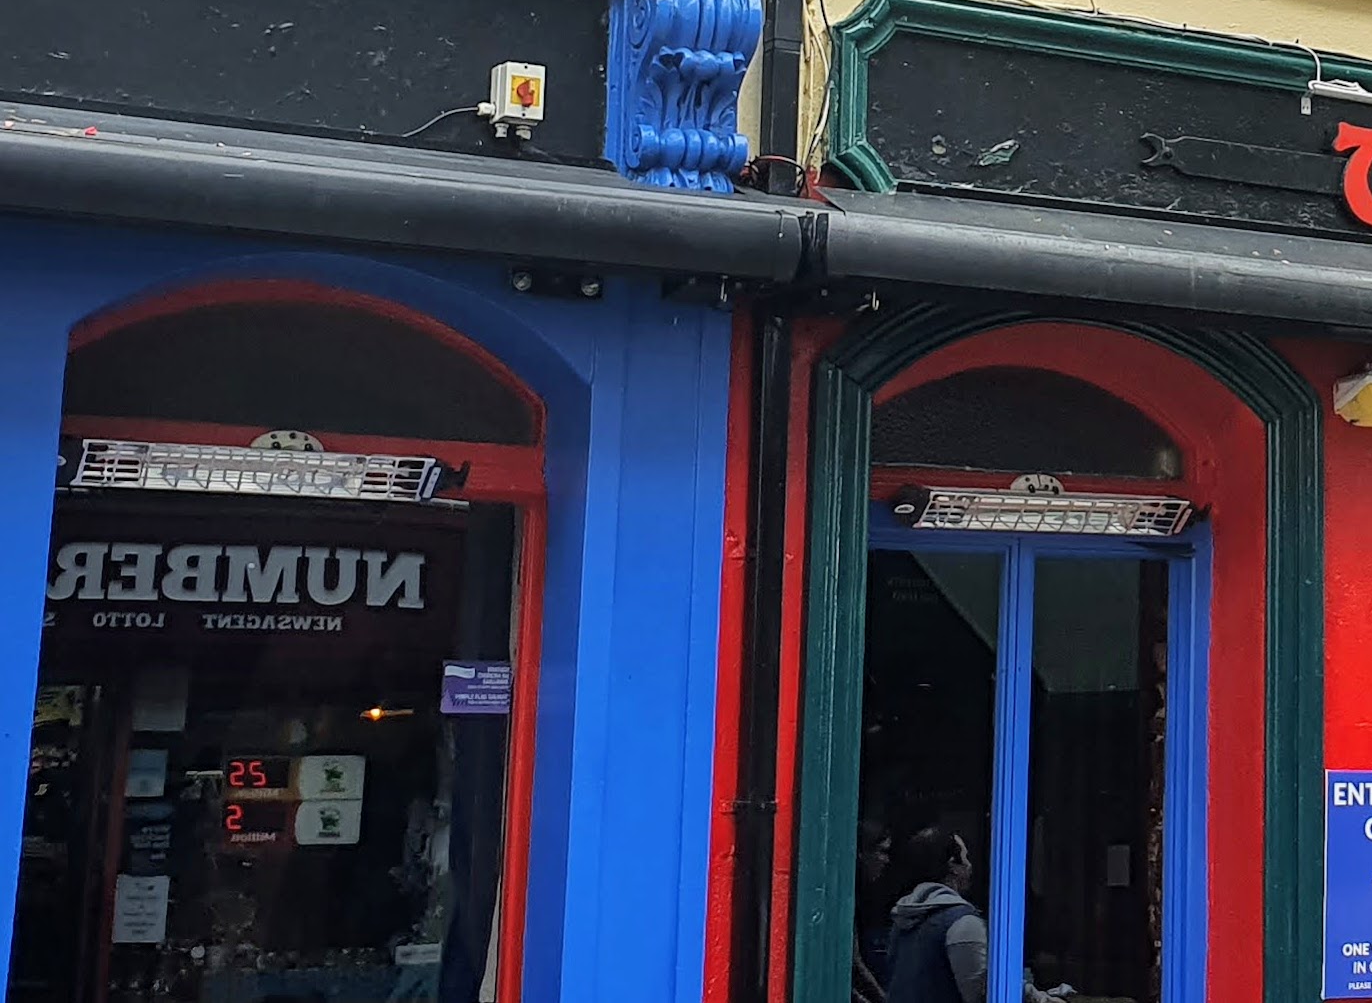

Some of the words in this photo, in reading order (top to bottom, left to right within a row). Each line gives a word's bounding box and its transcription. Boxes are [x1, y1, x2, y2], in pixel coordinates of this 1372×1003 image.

[1342, 942, 1371, 958] ONE
[1352, 960, 1367, 975] IN
[1348, 981, 1372, 991] PLEASE
